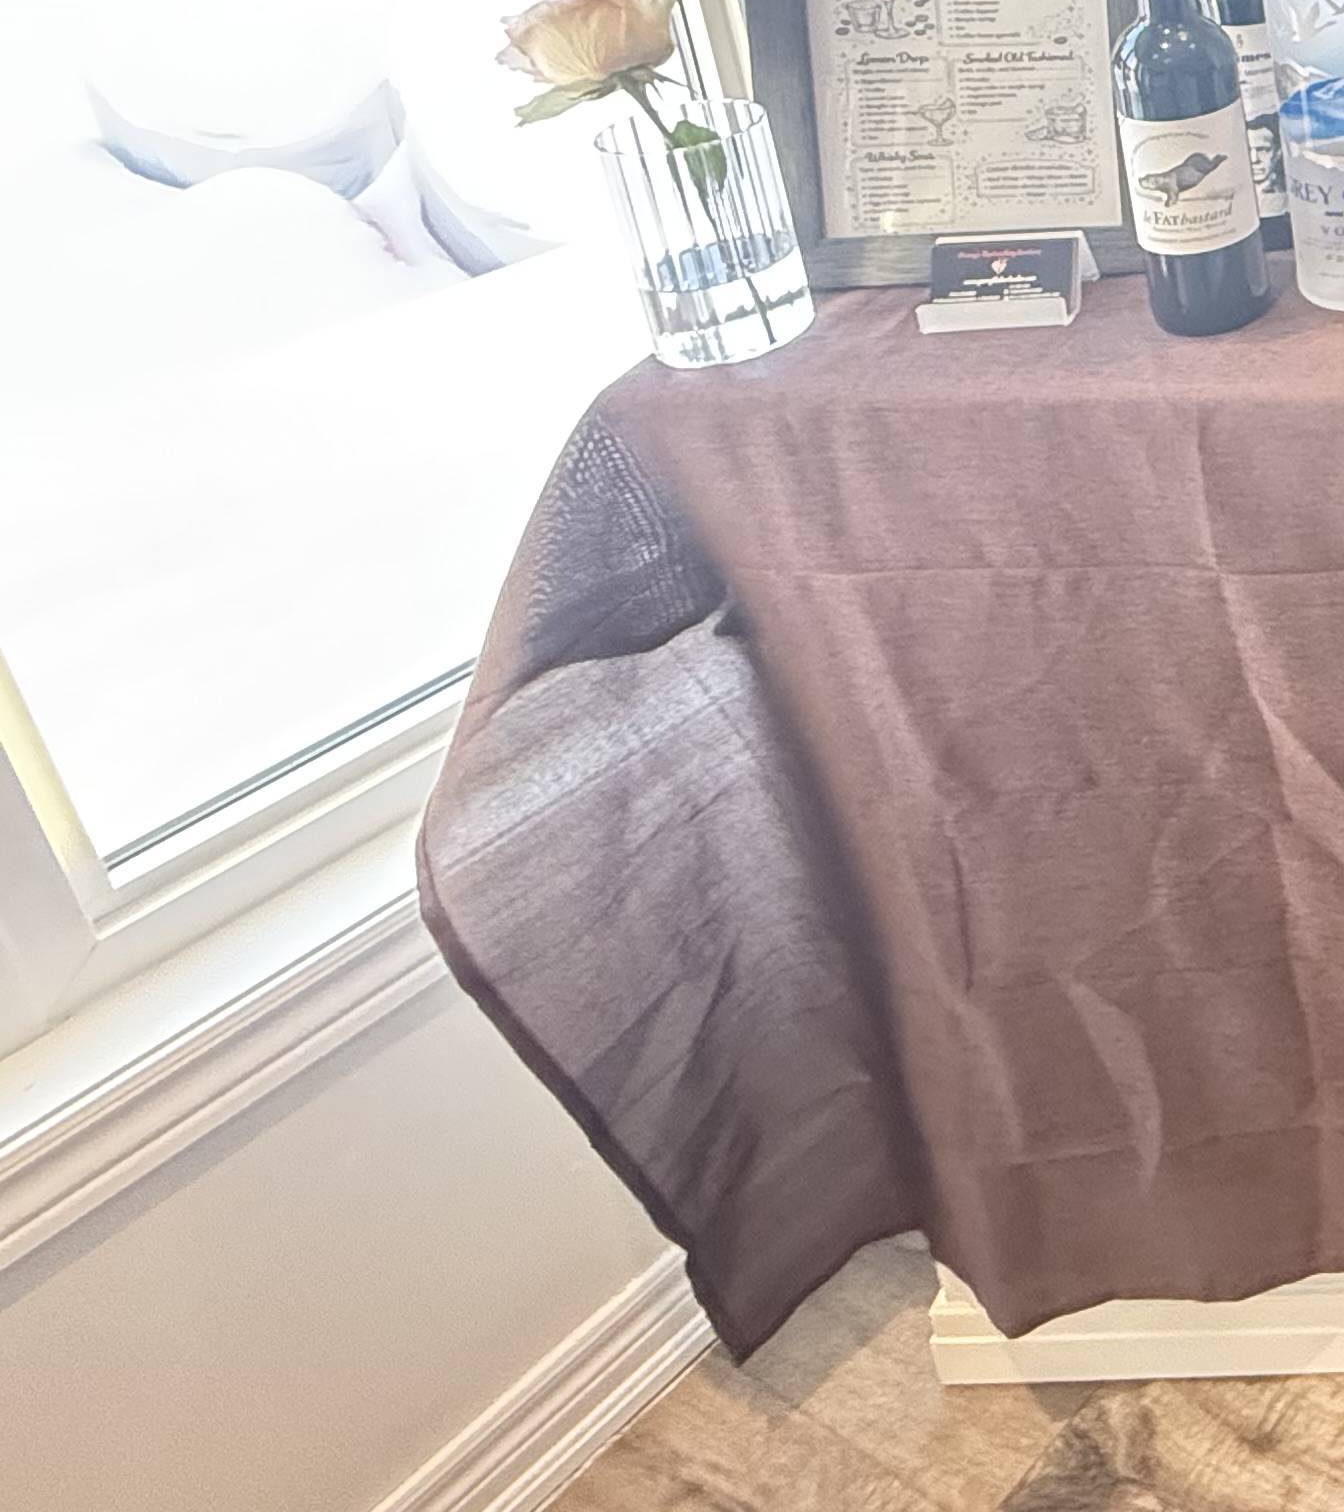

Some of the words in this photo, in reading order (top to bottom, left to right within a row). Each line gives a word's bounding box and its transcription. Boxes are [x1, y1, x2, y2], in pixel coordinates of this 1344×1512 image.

[896, 52, 930, 65] Drop
[1004, 51, 1024, 63] Old
[1025, 50, 1074, 62] Fashioned
